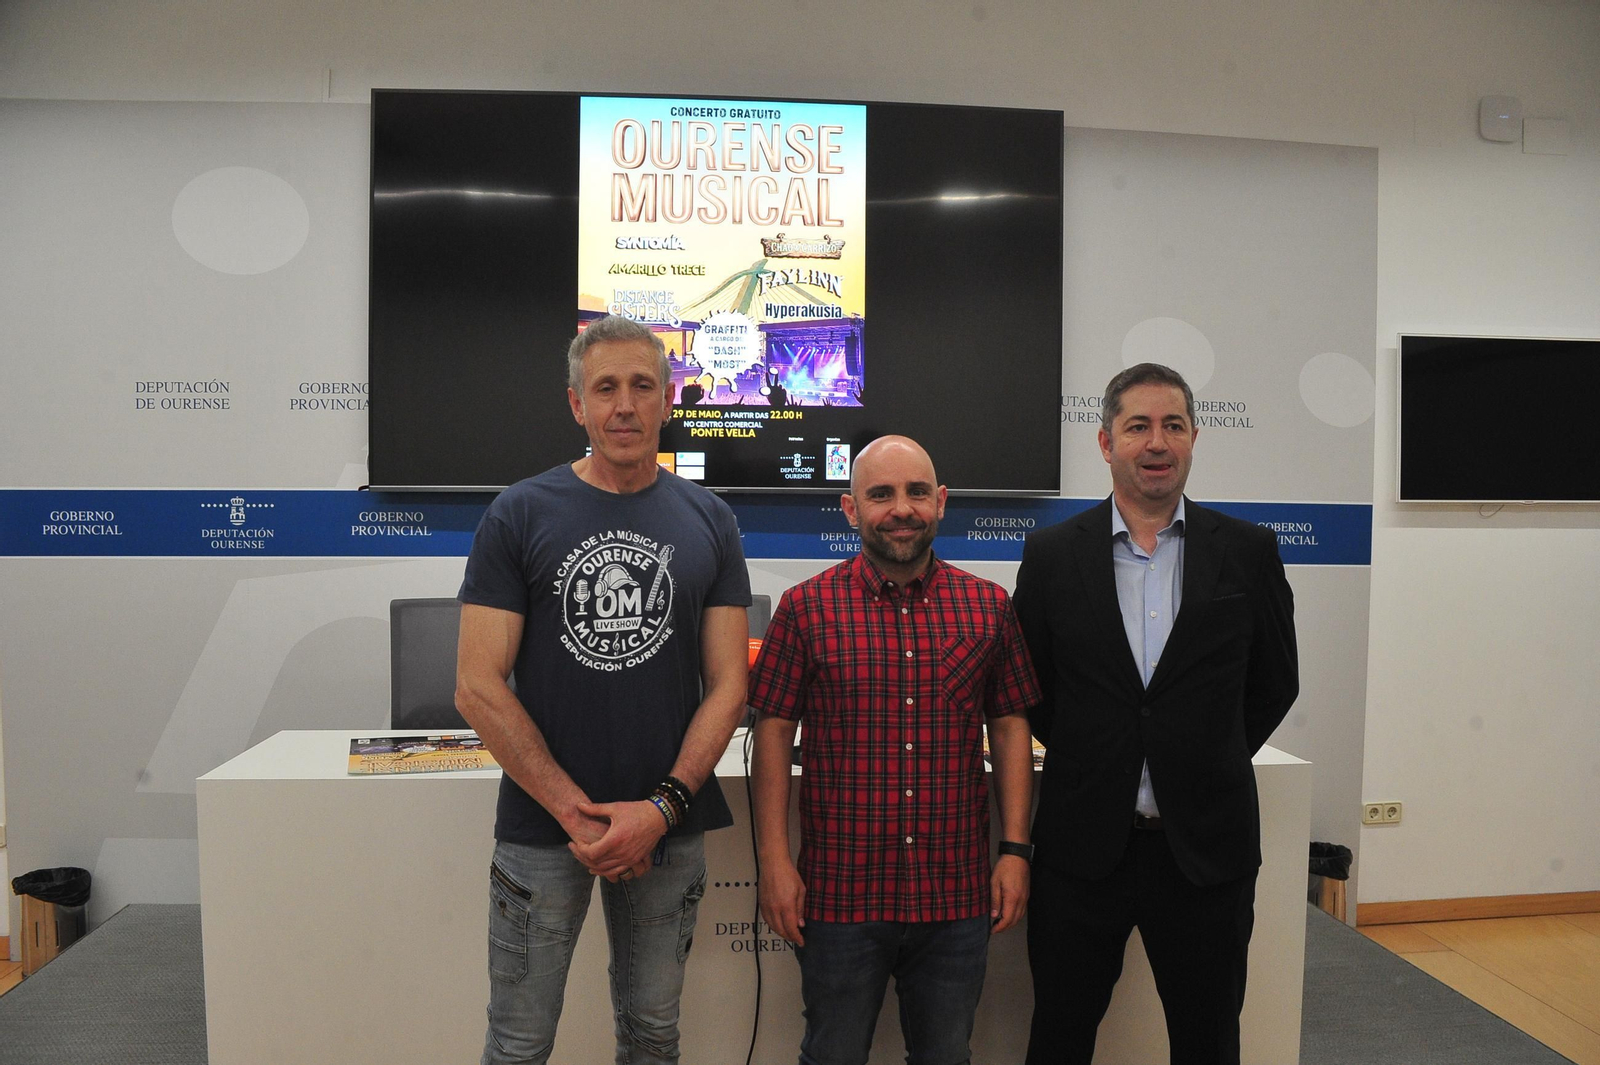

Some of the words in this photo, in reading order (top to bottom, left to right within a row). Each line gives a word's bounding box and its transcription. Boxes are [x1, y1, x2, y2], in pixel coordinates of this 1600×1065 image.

[670, 107, 726, 118] CONCERTO
[730, 108, 781, 119] GRATUITO
[612, 118, 845, 174] OURENSE
[610, 172, 844, 227] MUSICAL
[608, 264, 666, 276] AMARILLO
[671, 264, 706, 276] TRECE
[757, 269, 843, 298] FAYLINN
[614, 288, 674, 304] DISTANCE
[607, 302, 682, 328] SISTERS
[766, 303, 842, 318] Hyperakusia
[704, 325, 748, 334] GRAFFITI
[136, 379, 230, 394] DEPUTACIÓN
[136, 398, 156, 410] DE
[160, 398, 230, 410] OURENSE
[290, 398, 370, 410] PROVINCIA
[1194, 401, 1246, 413] OBERNO
[672, 410, 684, 418] 29
[686, 410, 697, 418] DE
[698, 410, 722, 420] MAIO,
[770, 411, 794, 419] 22.00
[690, 428, 724, 438] PONTE
[726, 428, 756, 438] VELLA
[50, 510, 114, 522] GOBERNO
[358, 511, 424, 523] GOBERNO
[974, 517, 1036, 528] GOBERNO
[42, 524, 122, 536] PROVINCIAL
[201, 528, 274, 538] DEPUTACIÓN
[350, 525, 432, 536] PROVINCIAL
[599, 530, 615, 542] LA
[967, 530, 1026, 542] PROVINCI
[210, 540, 265, 549] OURENSE
[581, 536, 598, 550] DE
[616, 530, 658, 551] MÚSICA
[830, 543, 860, 552] OURE
[557, 549, 583, 577] CASA
[582, 548, 653, 576] OURENSE
[553, 580, 562, 595] LA
[596, 588, 642, 618] OM
[596, 620, 615, 629] LIVE
[616, 619, 640, 628] SHOW
[574, 616, 662, 653] MUSICAL
[560, 634, 622, 672] DEPUTACIÓN
[626, 626, 674, 668] OURENSE
[731, 939, 794, 952] OUREN
